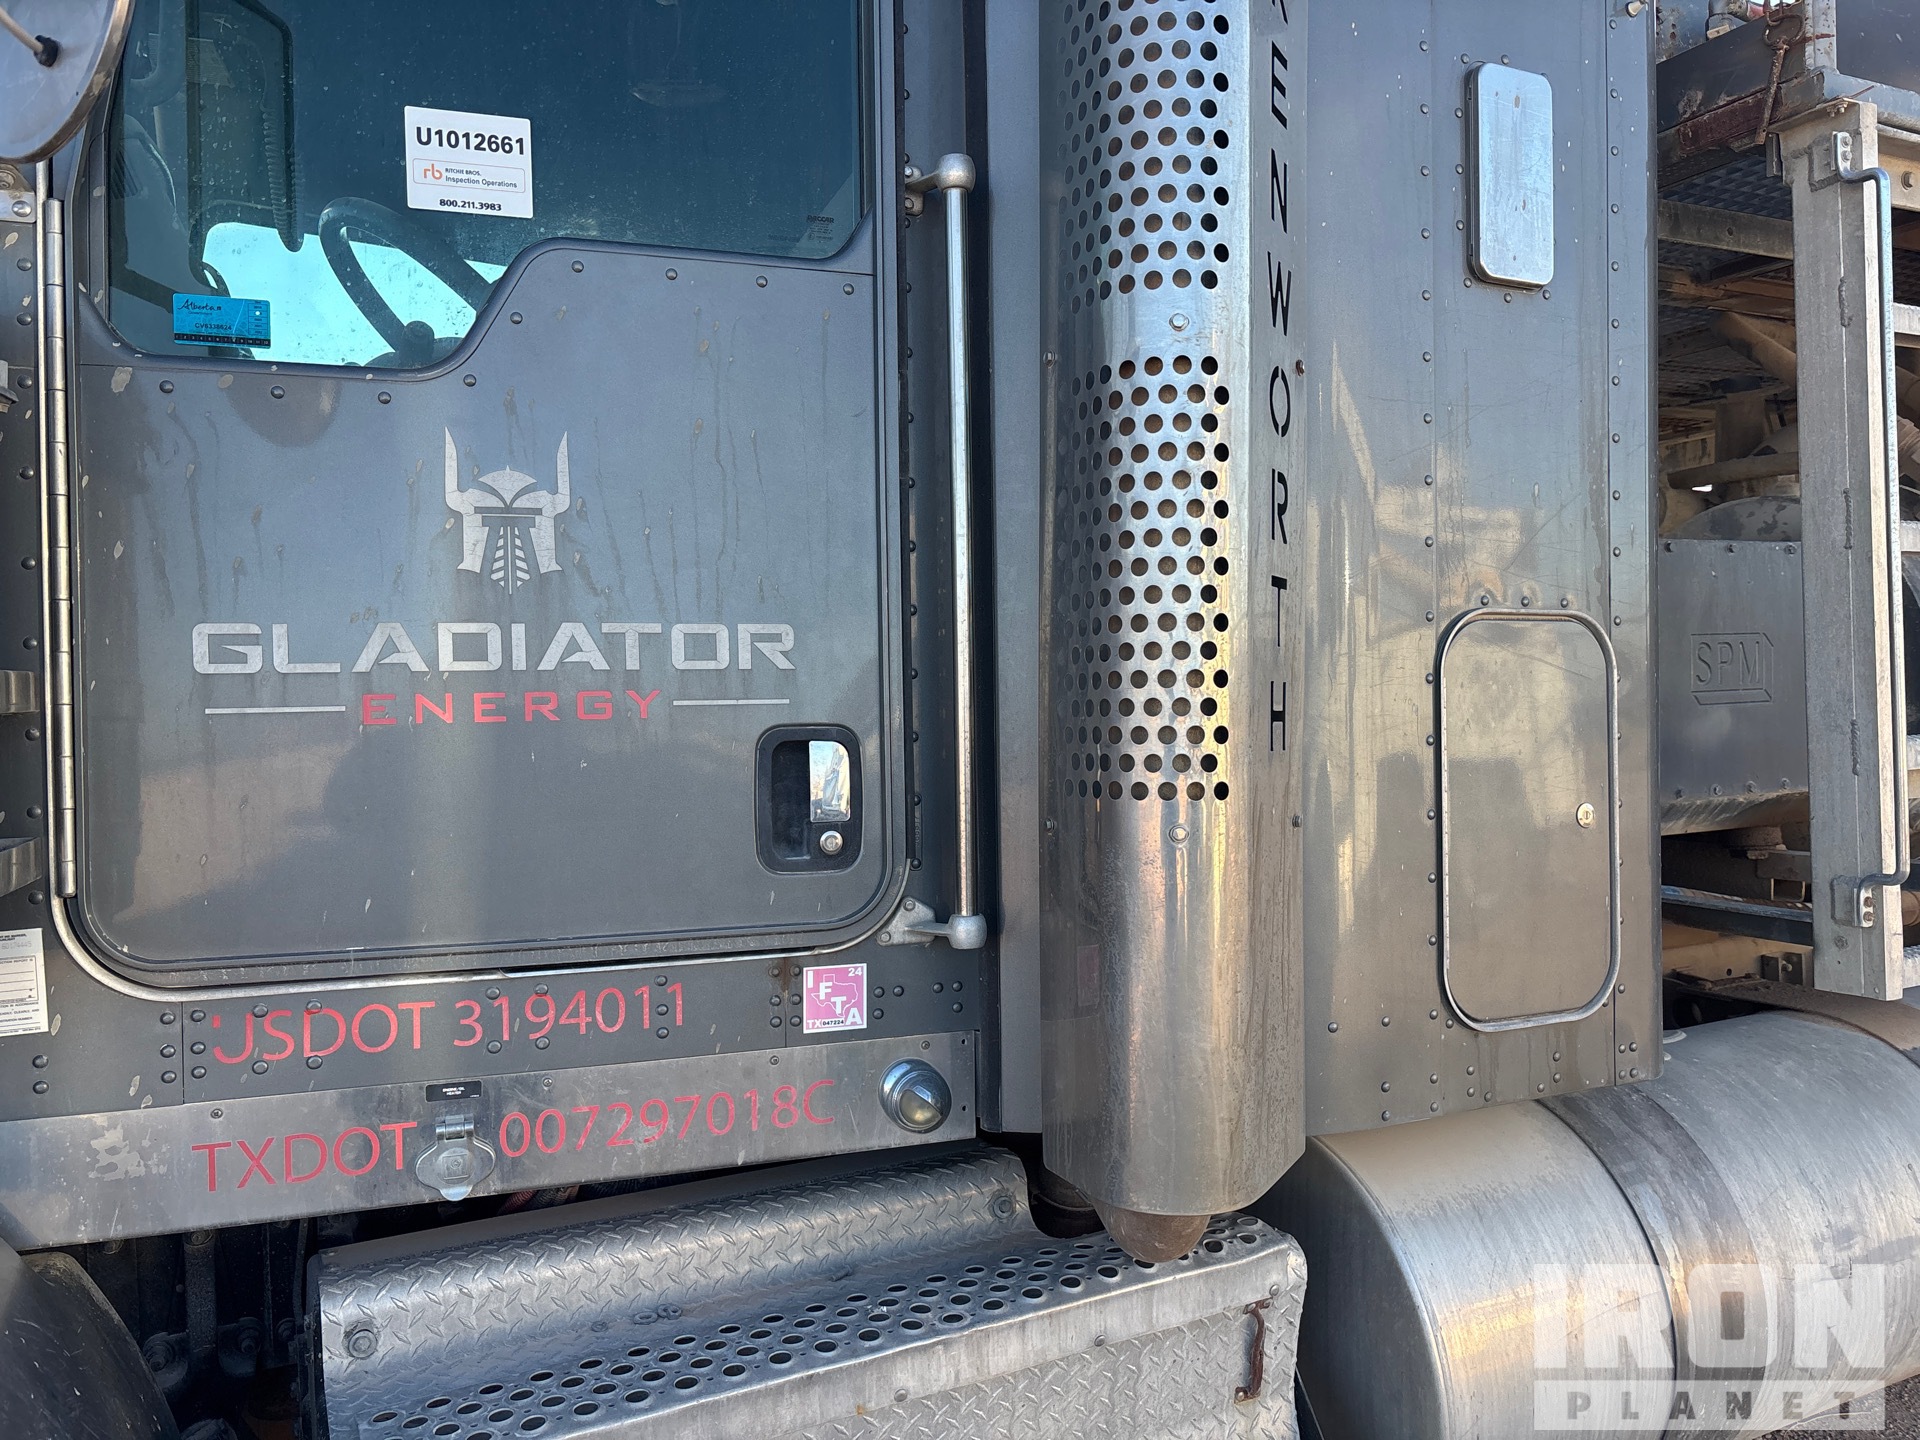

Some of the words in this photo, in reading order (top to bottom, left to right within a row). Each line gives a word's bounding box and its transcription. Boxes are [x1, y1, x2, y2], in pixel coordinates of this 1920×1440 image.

[416, 126, 525, 155] U1012661
[445, 167, 465, 175] RITCHIE
[445, 175, 481, 185] Inspection
[482, 178, 518, 189] Operations
[439, 198, 502, 211] 800.211.3983
[177, 298, 216, 311] Alberta
[1266, 0, 1292, 753] ENWORTH
[192, 622, 796, 675] GLADIATOR
[1695, 640, 1761, 687] SPM
[361, 689, 662, 726] ENERGY
[847, 967, 862, 977] 24
[212, 1001, 436, 1064] USDOT
[453, 982, 685, 1048] 3194011
[807, 1019, 821, 1029] TX
[191, 1121, 418, 1193] TXDOT
[498, 1079, 836, 1158] 007297018C
